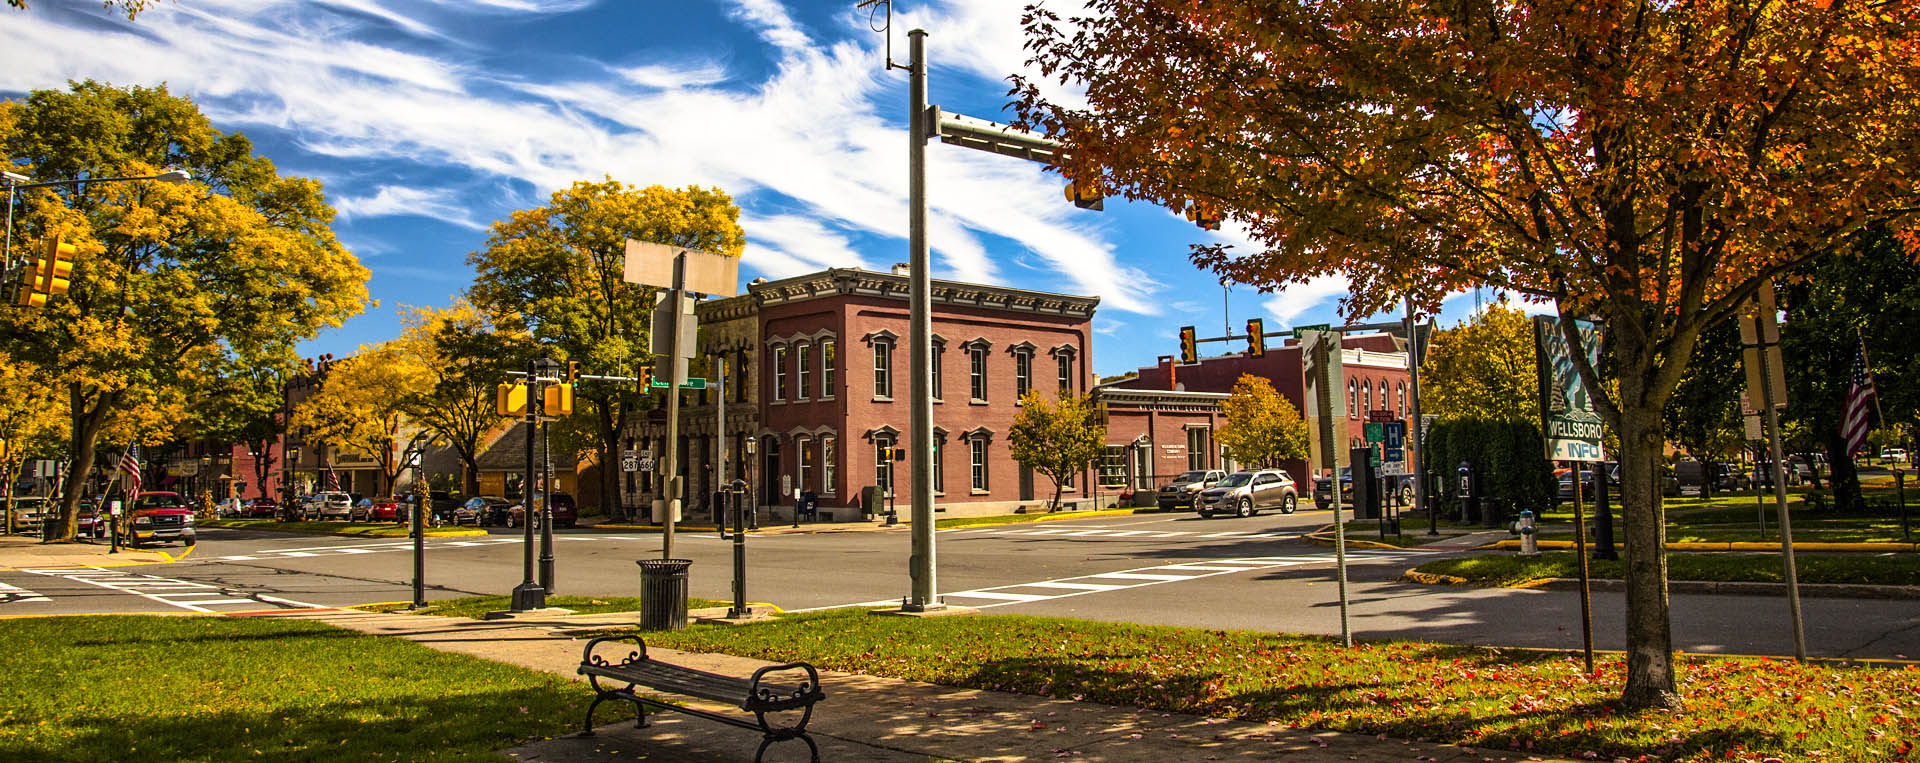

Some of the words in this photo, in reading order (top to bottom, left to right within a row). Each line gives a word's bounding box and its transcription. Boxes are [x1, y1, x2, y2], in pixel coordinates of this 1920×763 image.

[1388, 426, 1398, 445] H
[1549, 420, 1602, 439] WELLSBORO
[1567, 442, 1600, 458] INFO
[623, 460, 638, 470] 287
[640, 460, 654, 470] 660
